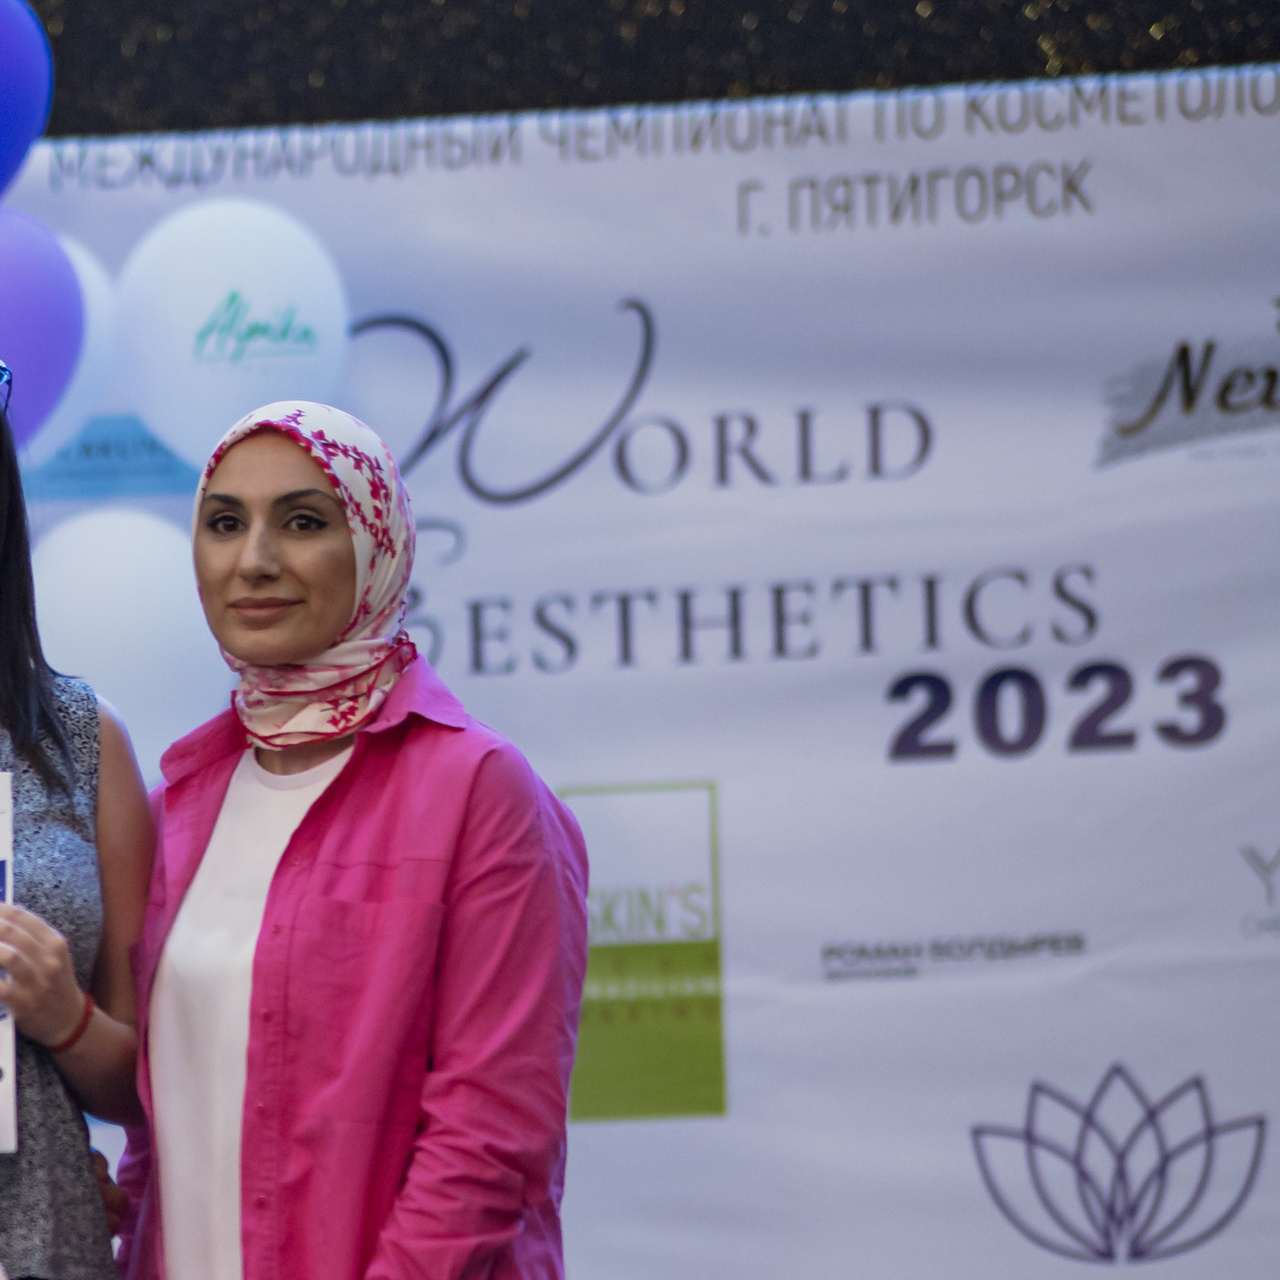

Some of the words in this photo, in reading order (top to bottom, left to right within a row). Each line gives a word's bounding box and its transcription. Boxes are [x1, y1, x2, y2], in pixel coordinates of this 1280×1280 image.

[538, 98, 848, 160] ЧЕМПИОНАТ
[873, 93, 946, 140] ПО
[736, 180, 773, 236] Г.
[787, 158, 1095, 234] ПЯТИГОРСК
[886, 652, 1229, 765] 2023
